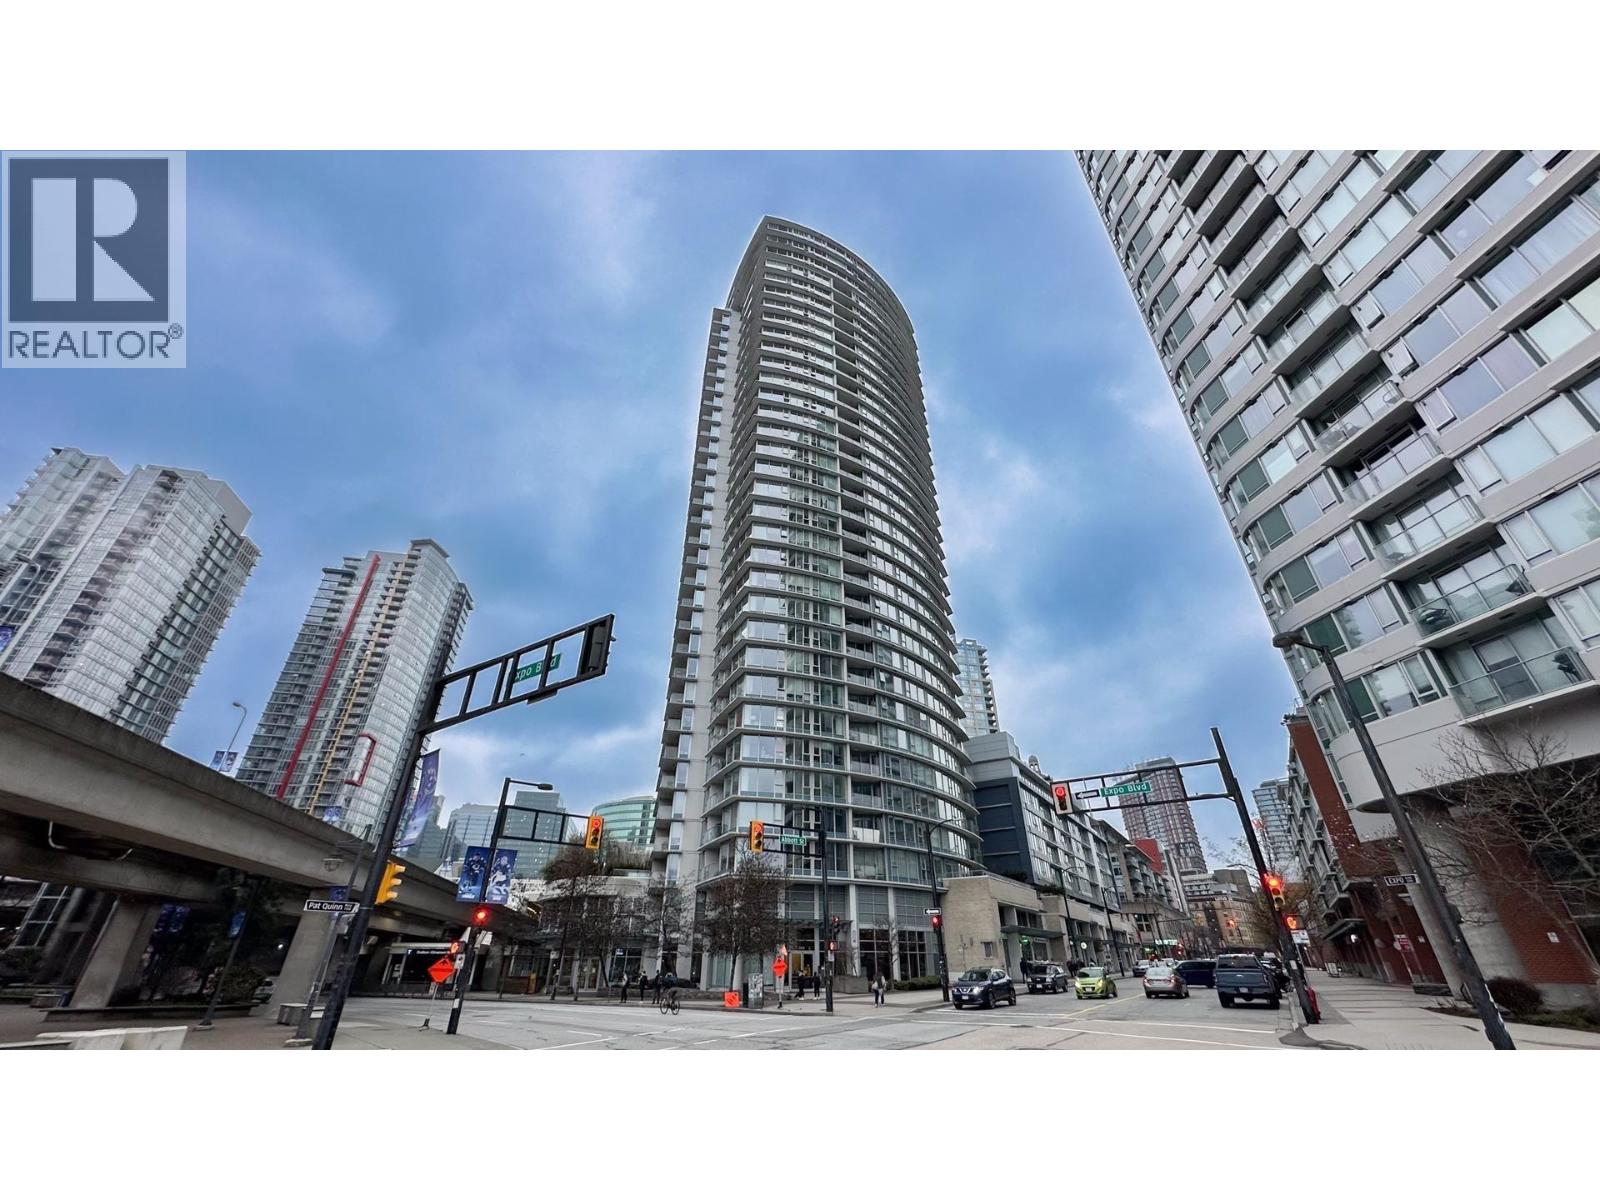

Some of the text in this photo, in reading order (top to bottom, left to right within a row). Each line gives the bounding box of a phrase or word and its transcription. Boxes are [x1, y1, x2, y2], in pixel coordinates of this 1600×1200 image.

[513, 659, 557, 681] xpo Bd
[1104, 783, 1147, 796] Expo Blvd
[322, 902, 343, 910] Quinn
